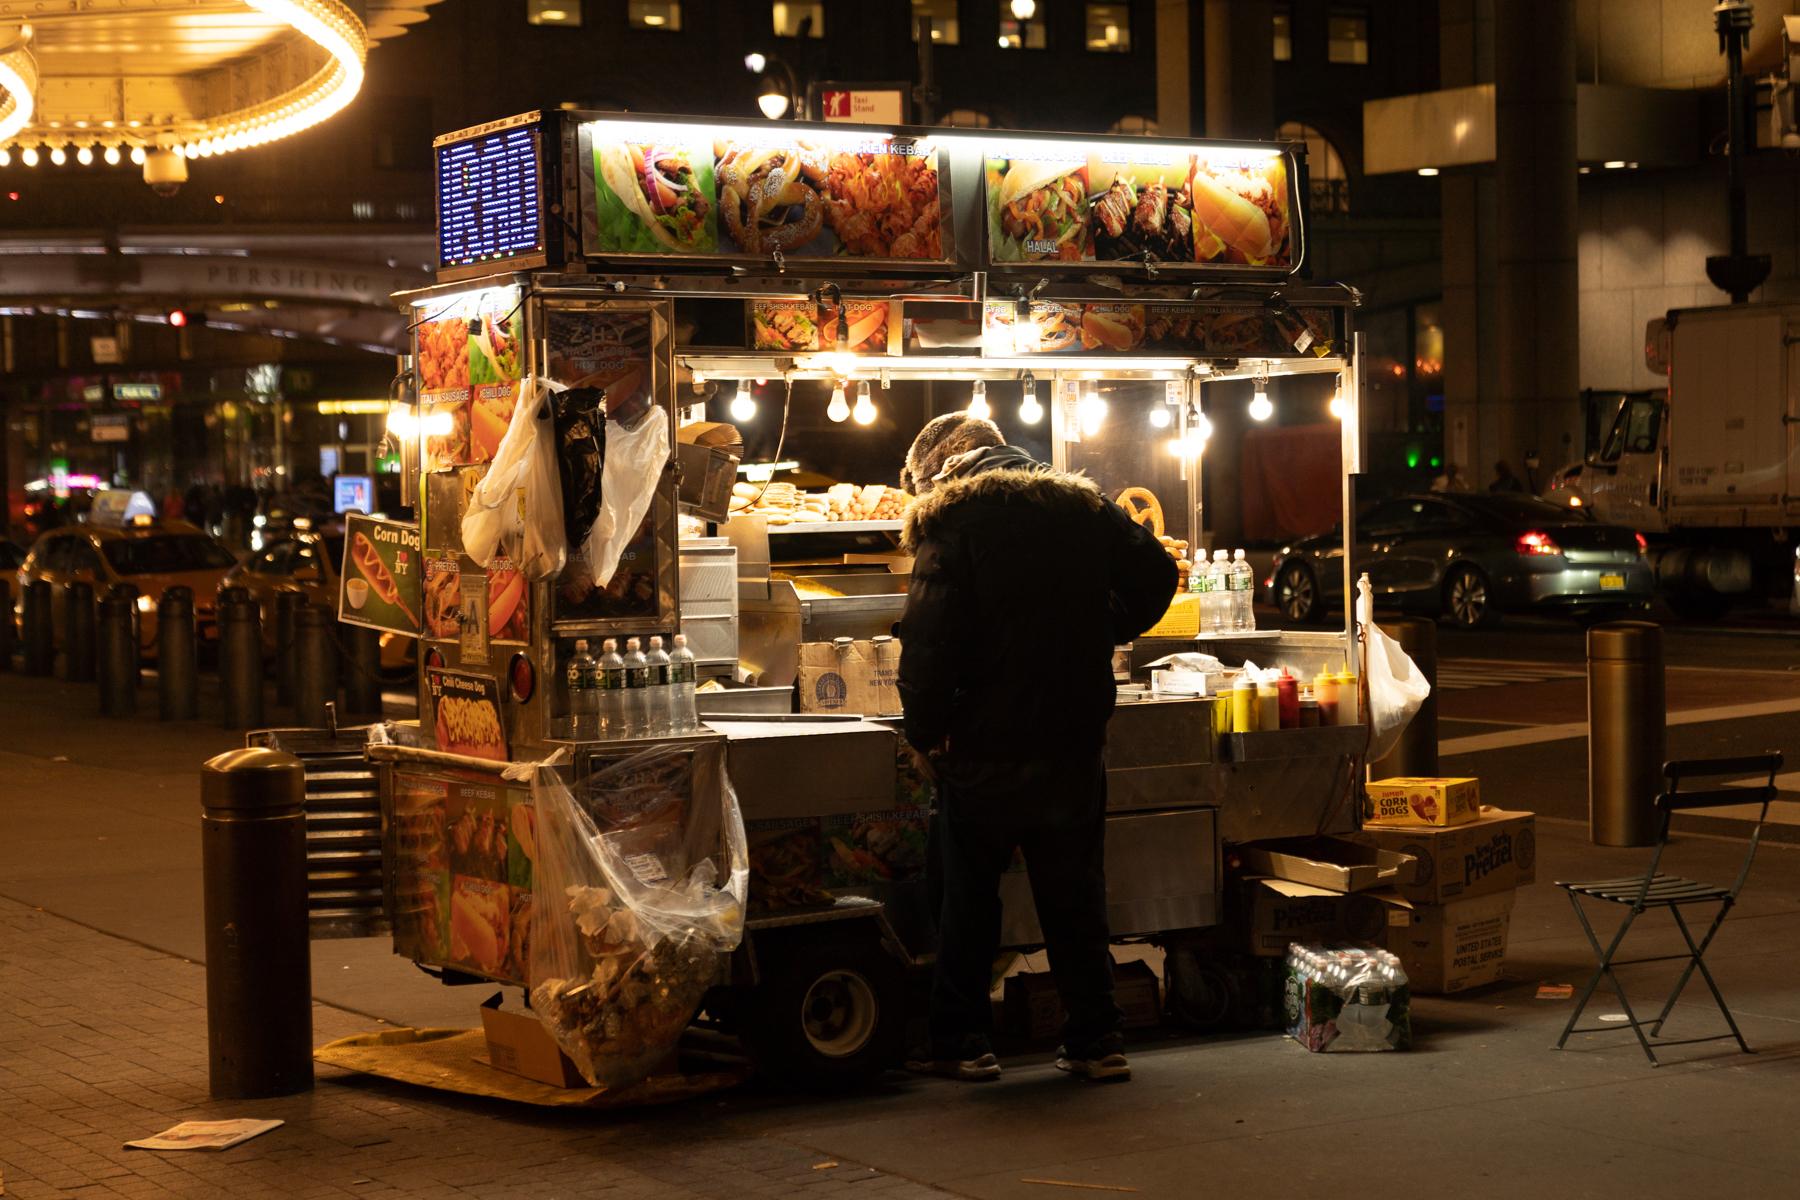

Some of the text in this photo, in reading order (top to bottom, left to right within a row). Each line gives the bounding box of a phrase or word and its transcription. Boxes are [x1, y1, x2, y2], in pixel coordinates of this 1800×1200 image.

[853, 96, 868, 104] Taxi
[853, 105, 875, 113] Stand
[740, 138, 799, 152] PRETZEL
[832, 141, 932, 157] CHICKEN KEBAB
[1101, 150, 1171, 166] BEEF KEBAB
[1027, 240, 1059, 254] HALAL
[207, 265, 369, 291] PERSHING
[749, 302, 815, 311] BEEF SHISH KEBAB
[835, 302, 872, 311] HOT DOG
[985, 306, 1006, 314] GYRO
[1151, 306, 1170, 314] BEEF
[1205, 307, 1231, 315] ITALIAN
[1233, 308, 1265, 316] SAUSAGE
[569, 326, 627, 345] Z-H-Y
[565, 346, 632, 356] HALAL FOOD
[574, 360, 625, 371] HOT DOG
[420, 390, 469, 405] ITALIAN SAUSAGE
[482, 385, 512, 399] CHILI DOG
[373, 524, 420, 552] Corn Dog
[394, 562, 408, 575] NY
[434, 561, 460, 573] PRETZEL
[500, 559, 513, 572] DOG
[467, 599, 480, 635] A
[442, 675, 486, 696] Chili Cheese Dog
[869, 678, 897, 687] NEW YOR
[431, 685, 442, 697] NY
[418, 783, 444, 795] SAUSAGE
[460, 787, 496, 801] BEEF KEBAB
[1381, 790, 1404, 798] JUMBO
[520, 796, 533, 807] LAM
[1379, 797, 1408, 807] CORN
[829, 814, 856, 826] BEEF
[892, 809, 928, 821] KEBAB
[1380, 806, 1409, 816] DOGS
[757, 817, 810, 831] SAUSAGE
[1464, 835, 1512, 887] Pretzel
[425, 874, 441, 884] GYRO
[465, 881, 494, 895] CHILI DOG
[519, 892, 533, 903] HOT
[1456, 936, 1502, 955] UNITED STATES
[1453, 955, 1478, 968] POSTAL
[1479, 947, 1504, 963] SERVICE
